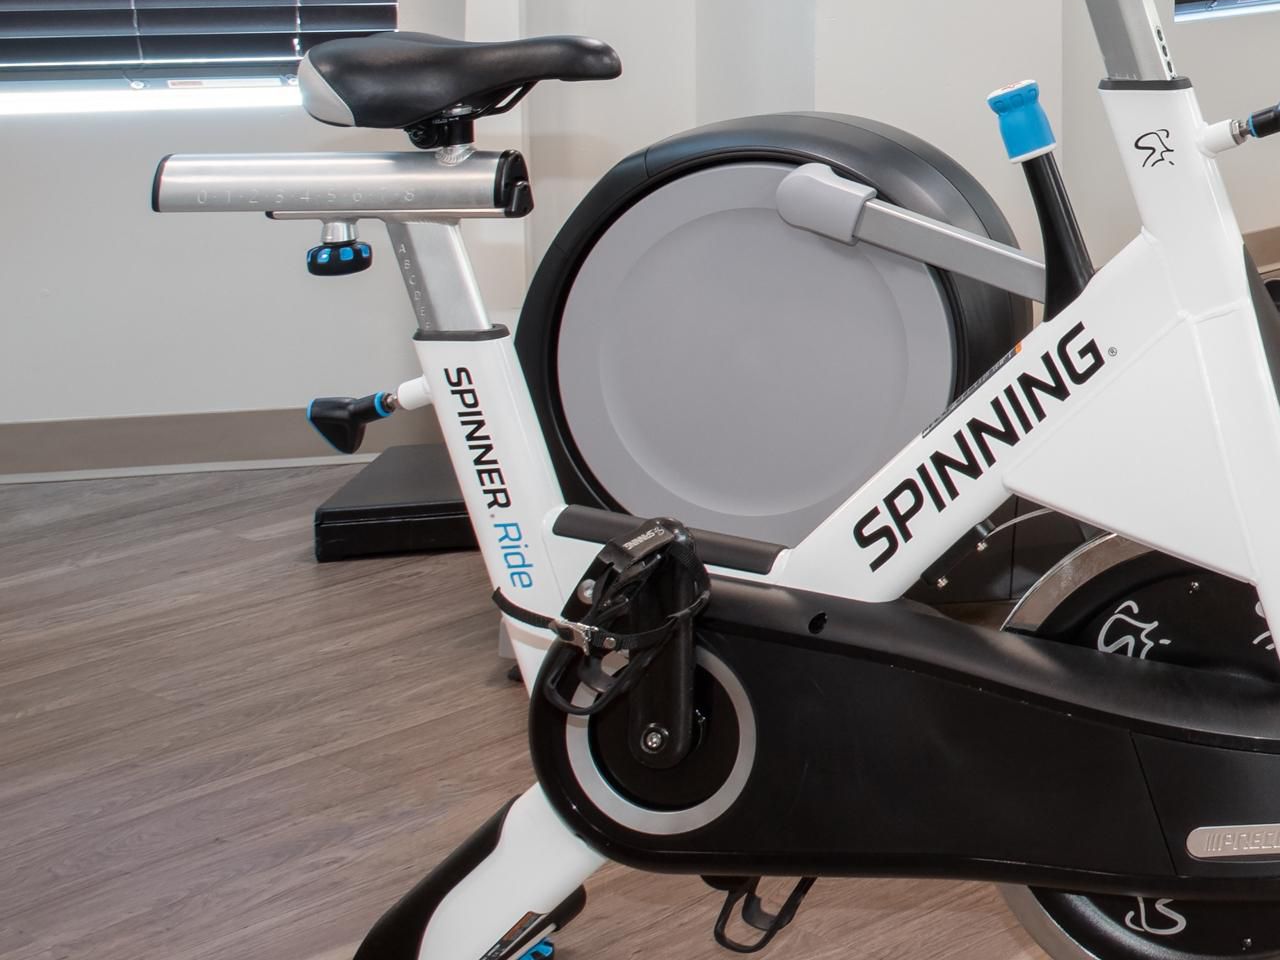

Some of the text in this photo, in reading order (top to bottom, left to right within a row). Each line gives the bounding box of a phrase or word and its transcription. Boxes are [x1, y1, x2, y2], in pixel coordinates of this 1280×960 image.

[443, 366, 534, 589] SPINNER Ride
[852, 321, 1106, 572] SPINNING
